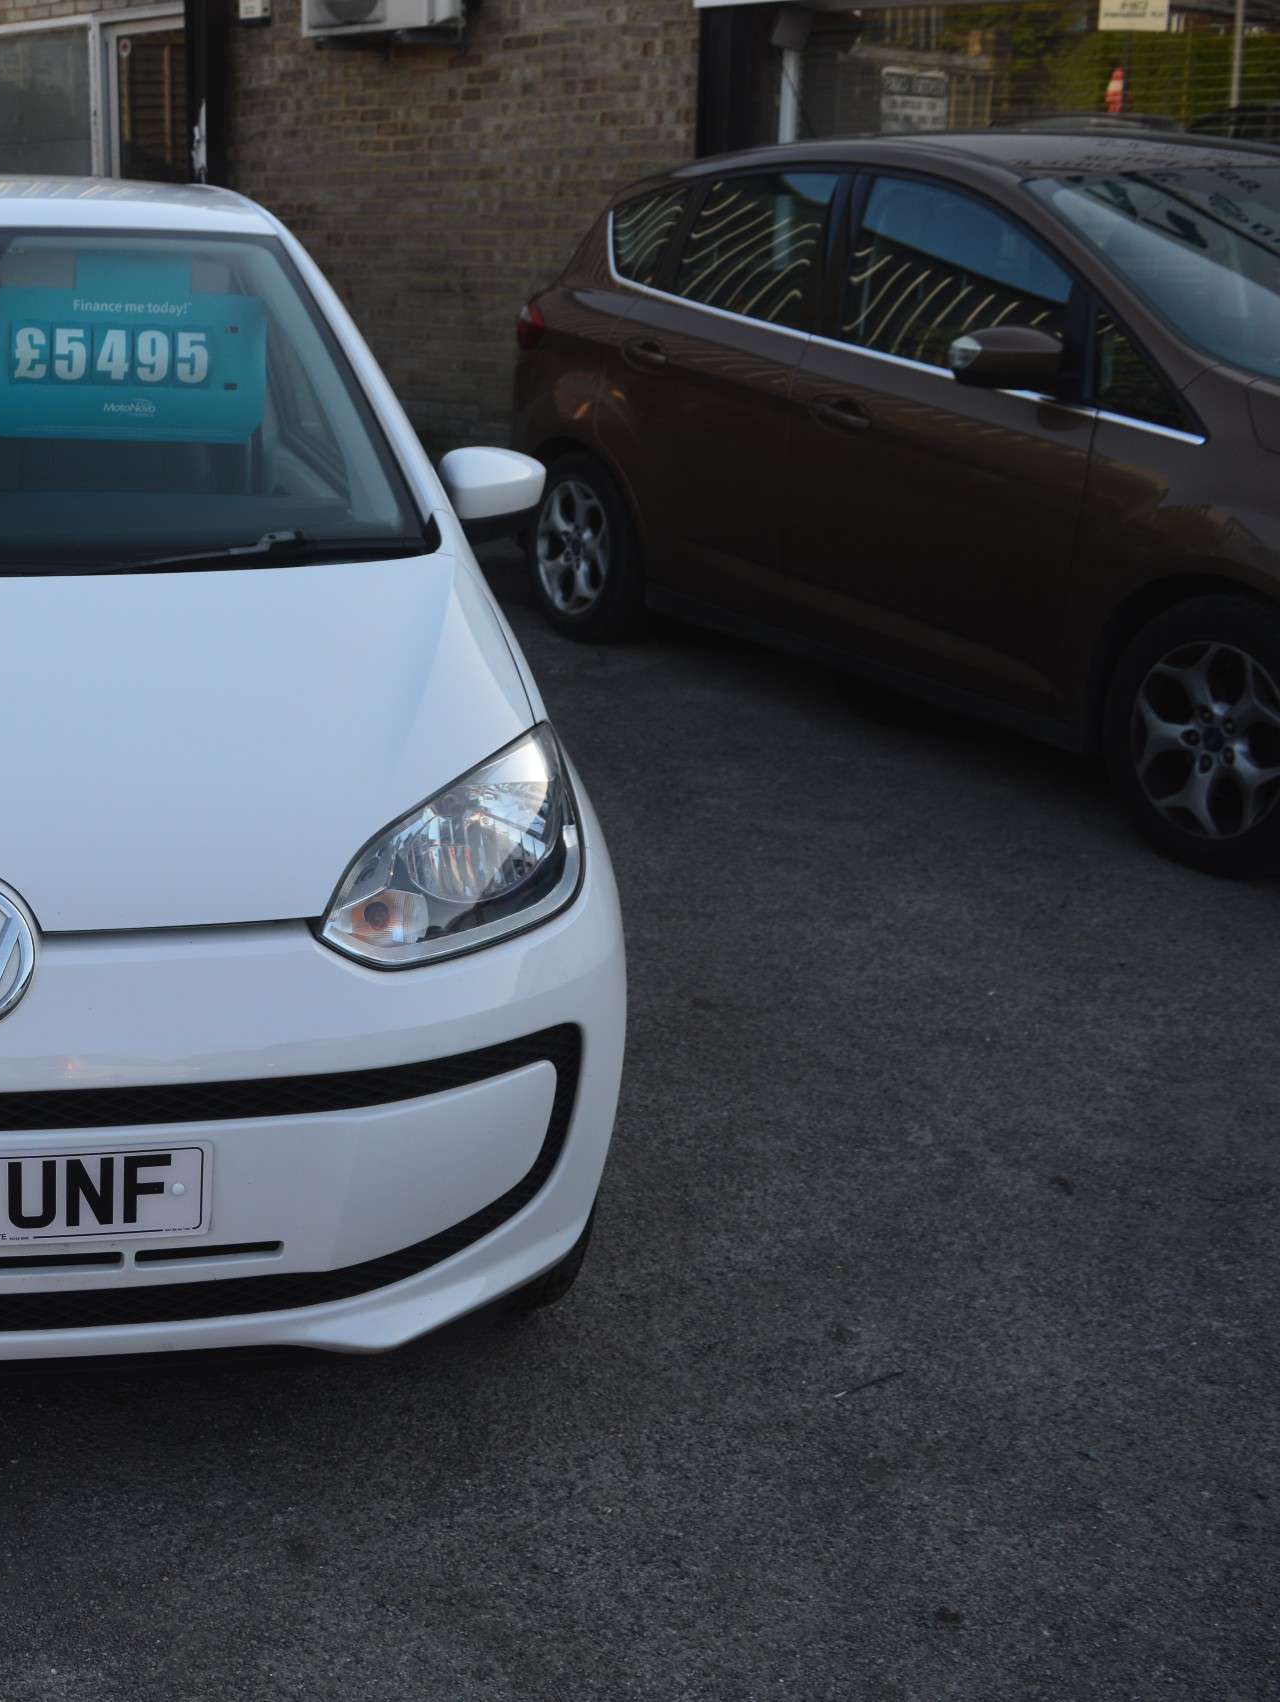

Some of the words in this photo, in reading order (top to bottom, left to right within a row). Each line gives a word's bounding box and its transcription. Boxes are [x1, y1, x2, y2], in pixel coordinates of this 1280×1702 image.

[72, 298, 121, 312] Finance
[124, 302, 145, 313] me
[13, 326, 210, 384] £5495
[7, 1153, 173, 1229] UNF
